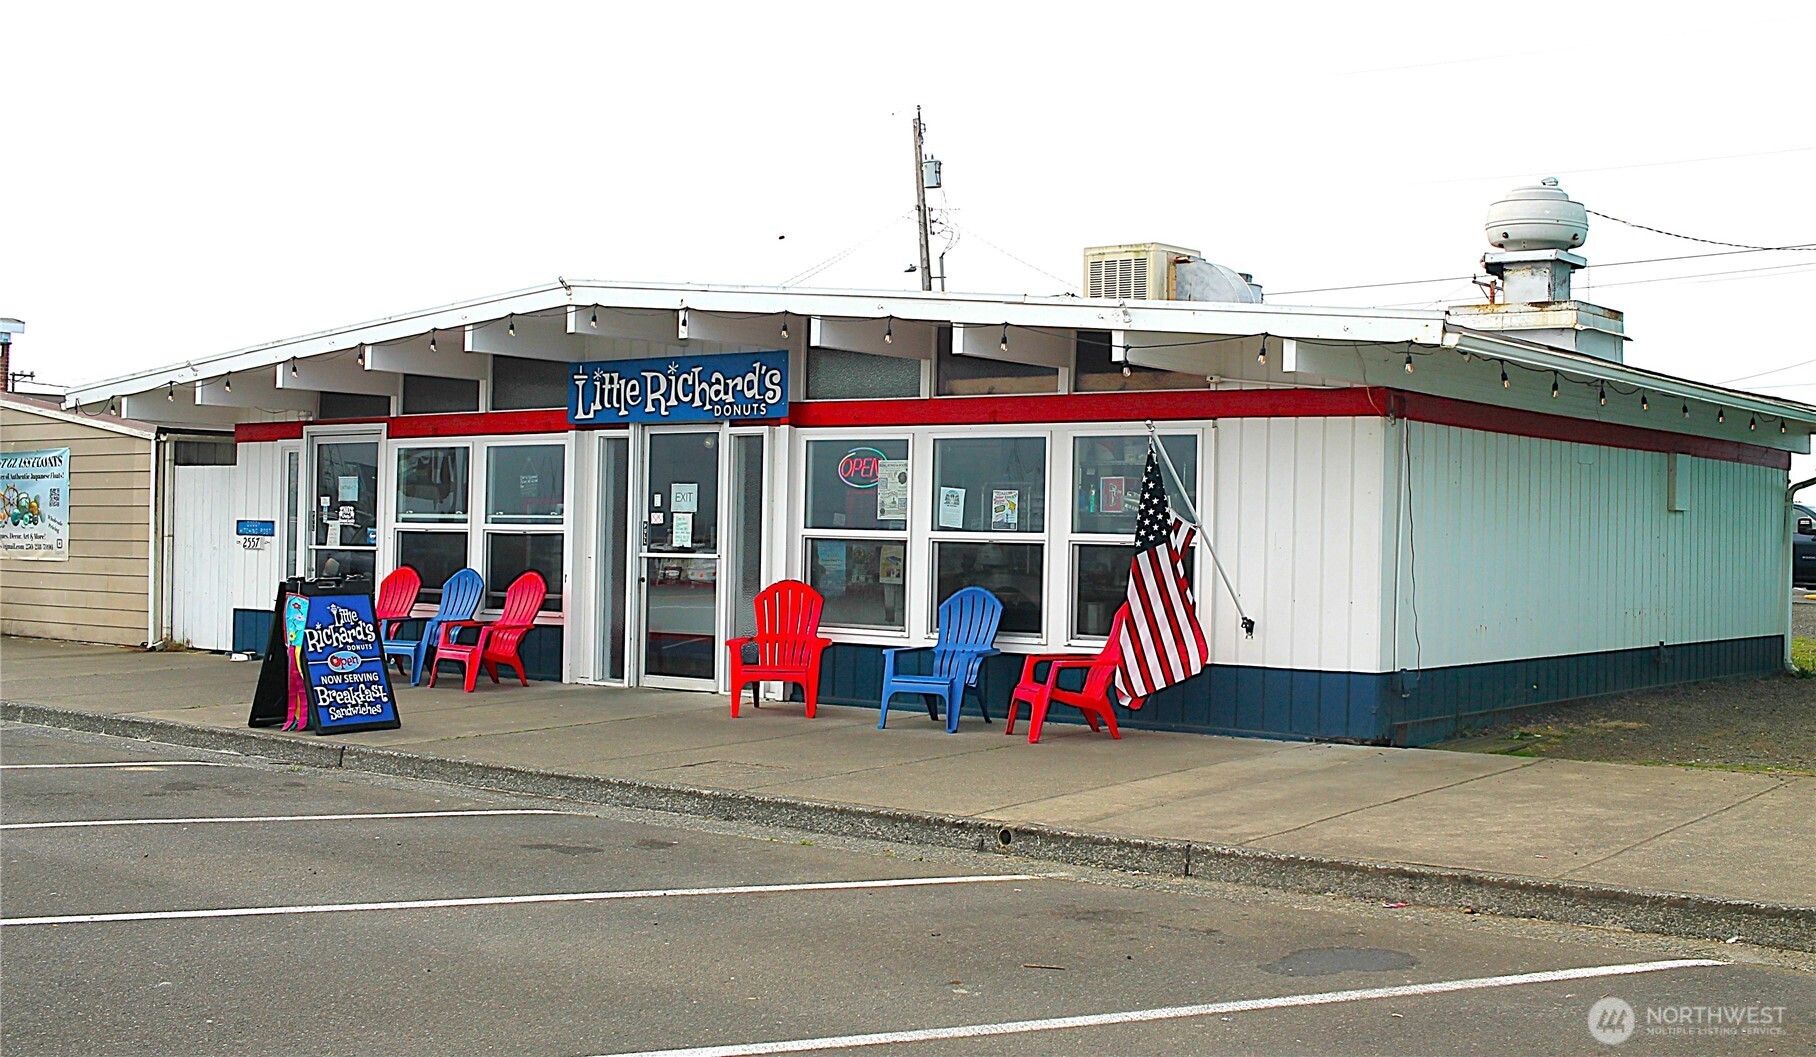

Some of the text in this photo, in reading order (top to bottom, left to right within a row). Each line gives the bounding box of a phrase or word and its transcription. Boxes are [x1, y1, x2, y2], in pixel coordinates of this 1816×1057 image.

[574, 361, 782, 419] Little Richard's
[714, 403, 767, 416] DONUTS
[32, 455, 63, 468] FLOATS
[841, 458, 881, 478] OPEN
[675, 492, 693, 502] EXIT
[243, 537, 260, 548] 2557
[330, 605, 358, 626] Little
[305, 621, 376, 652] Richard's
[330, 655, 359, 669] Open
[321, 672, 379, 684] NOW SERVING
[314, 684, 388, 706] Breakfast
[329, 703, 382, 720] Sandwiches
